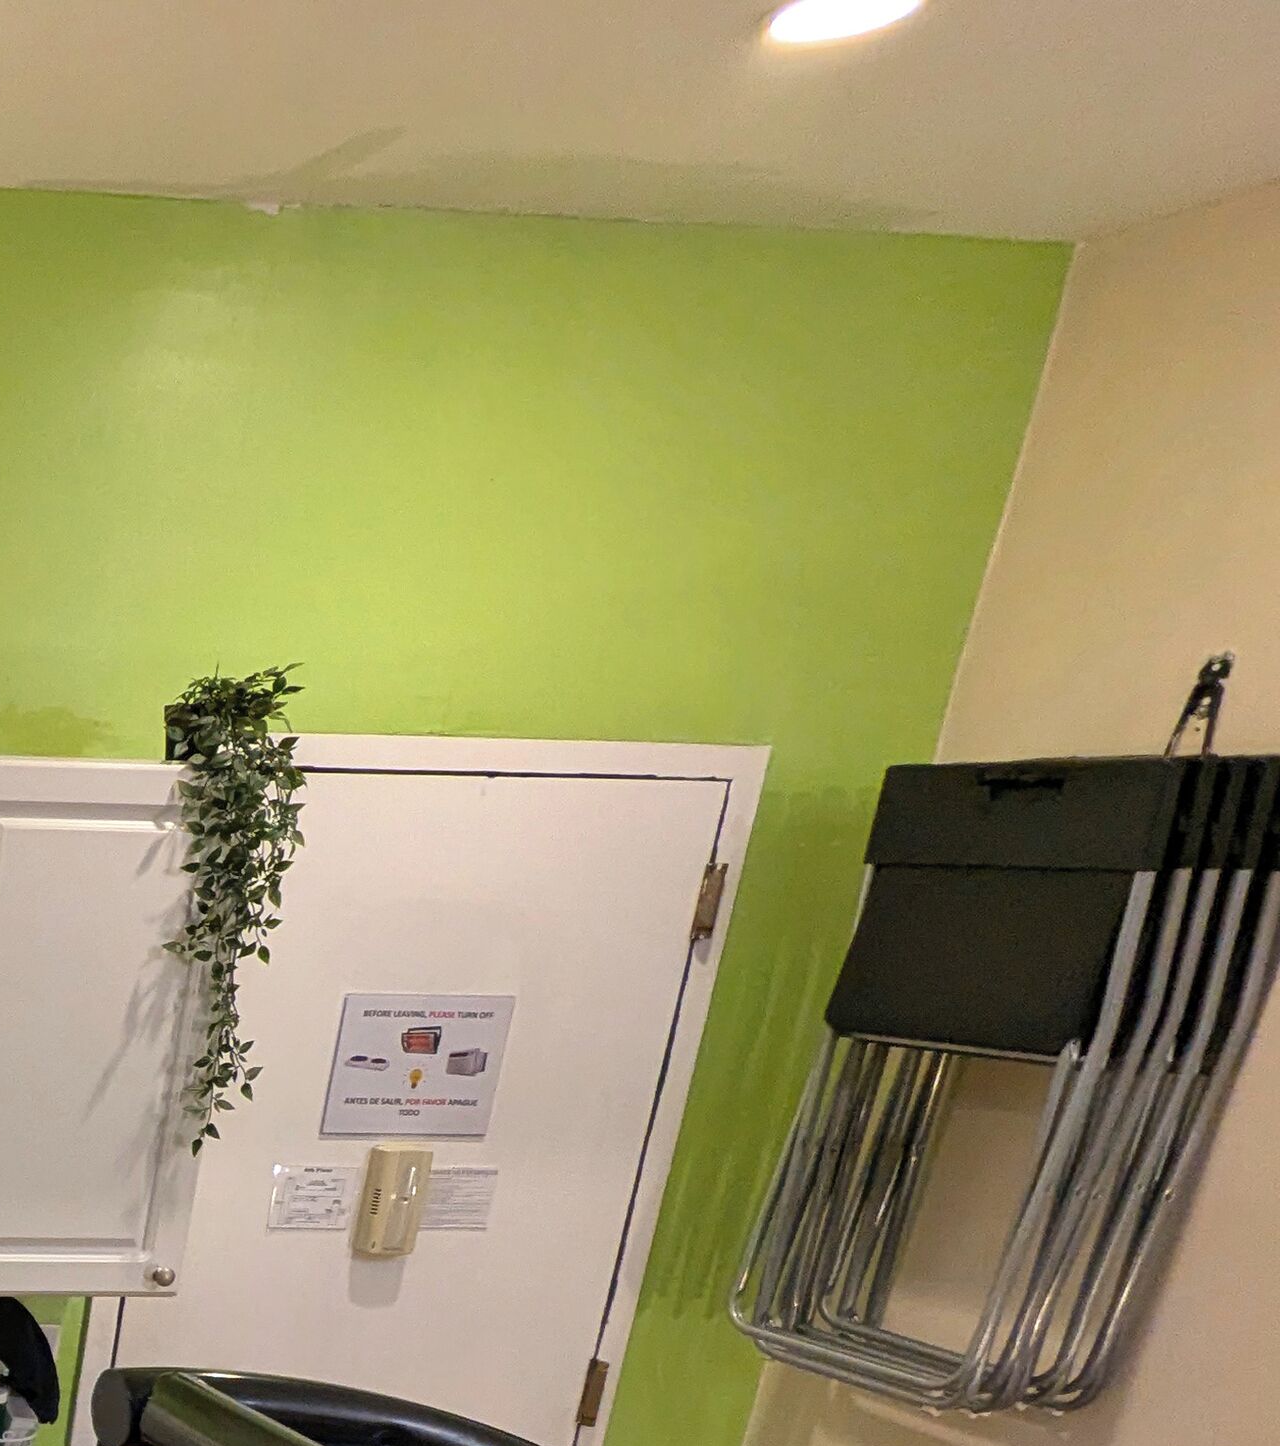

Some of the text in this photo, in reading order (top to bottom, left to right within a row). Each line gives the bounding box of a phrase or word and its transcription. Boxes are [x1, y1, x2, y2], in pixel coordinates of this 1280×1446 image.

[363, 1009, 392, 1018] BEFORE
[428, 1011, 456, 1019] PLEASE
[457, 1011, 478, 1019] TURN
[479, 1011, 495, 1019] OFF
[344, 1097, 369, 1105] ANTES
[369, 1097, 380, 1105] DE
[405, 1098, 421, 1106] POR
[422, 1098, 448, 1106] FAVOR
[447, 1099, 479, 1107] APAGUE
[399, 1109, 420, 1117] TODO
